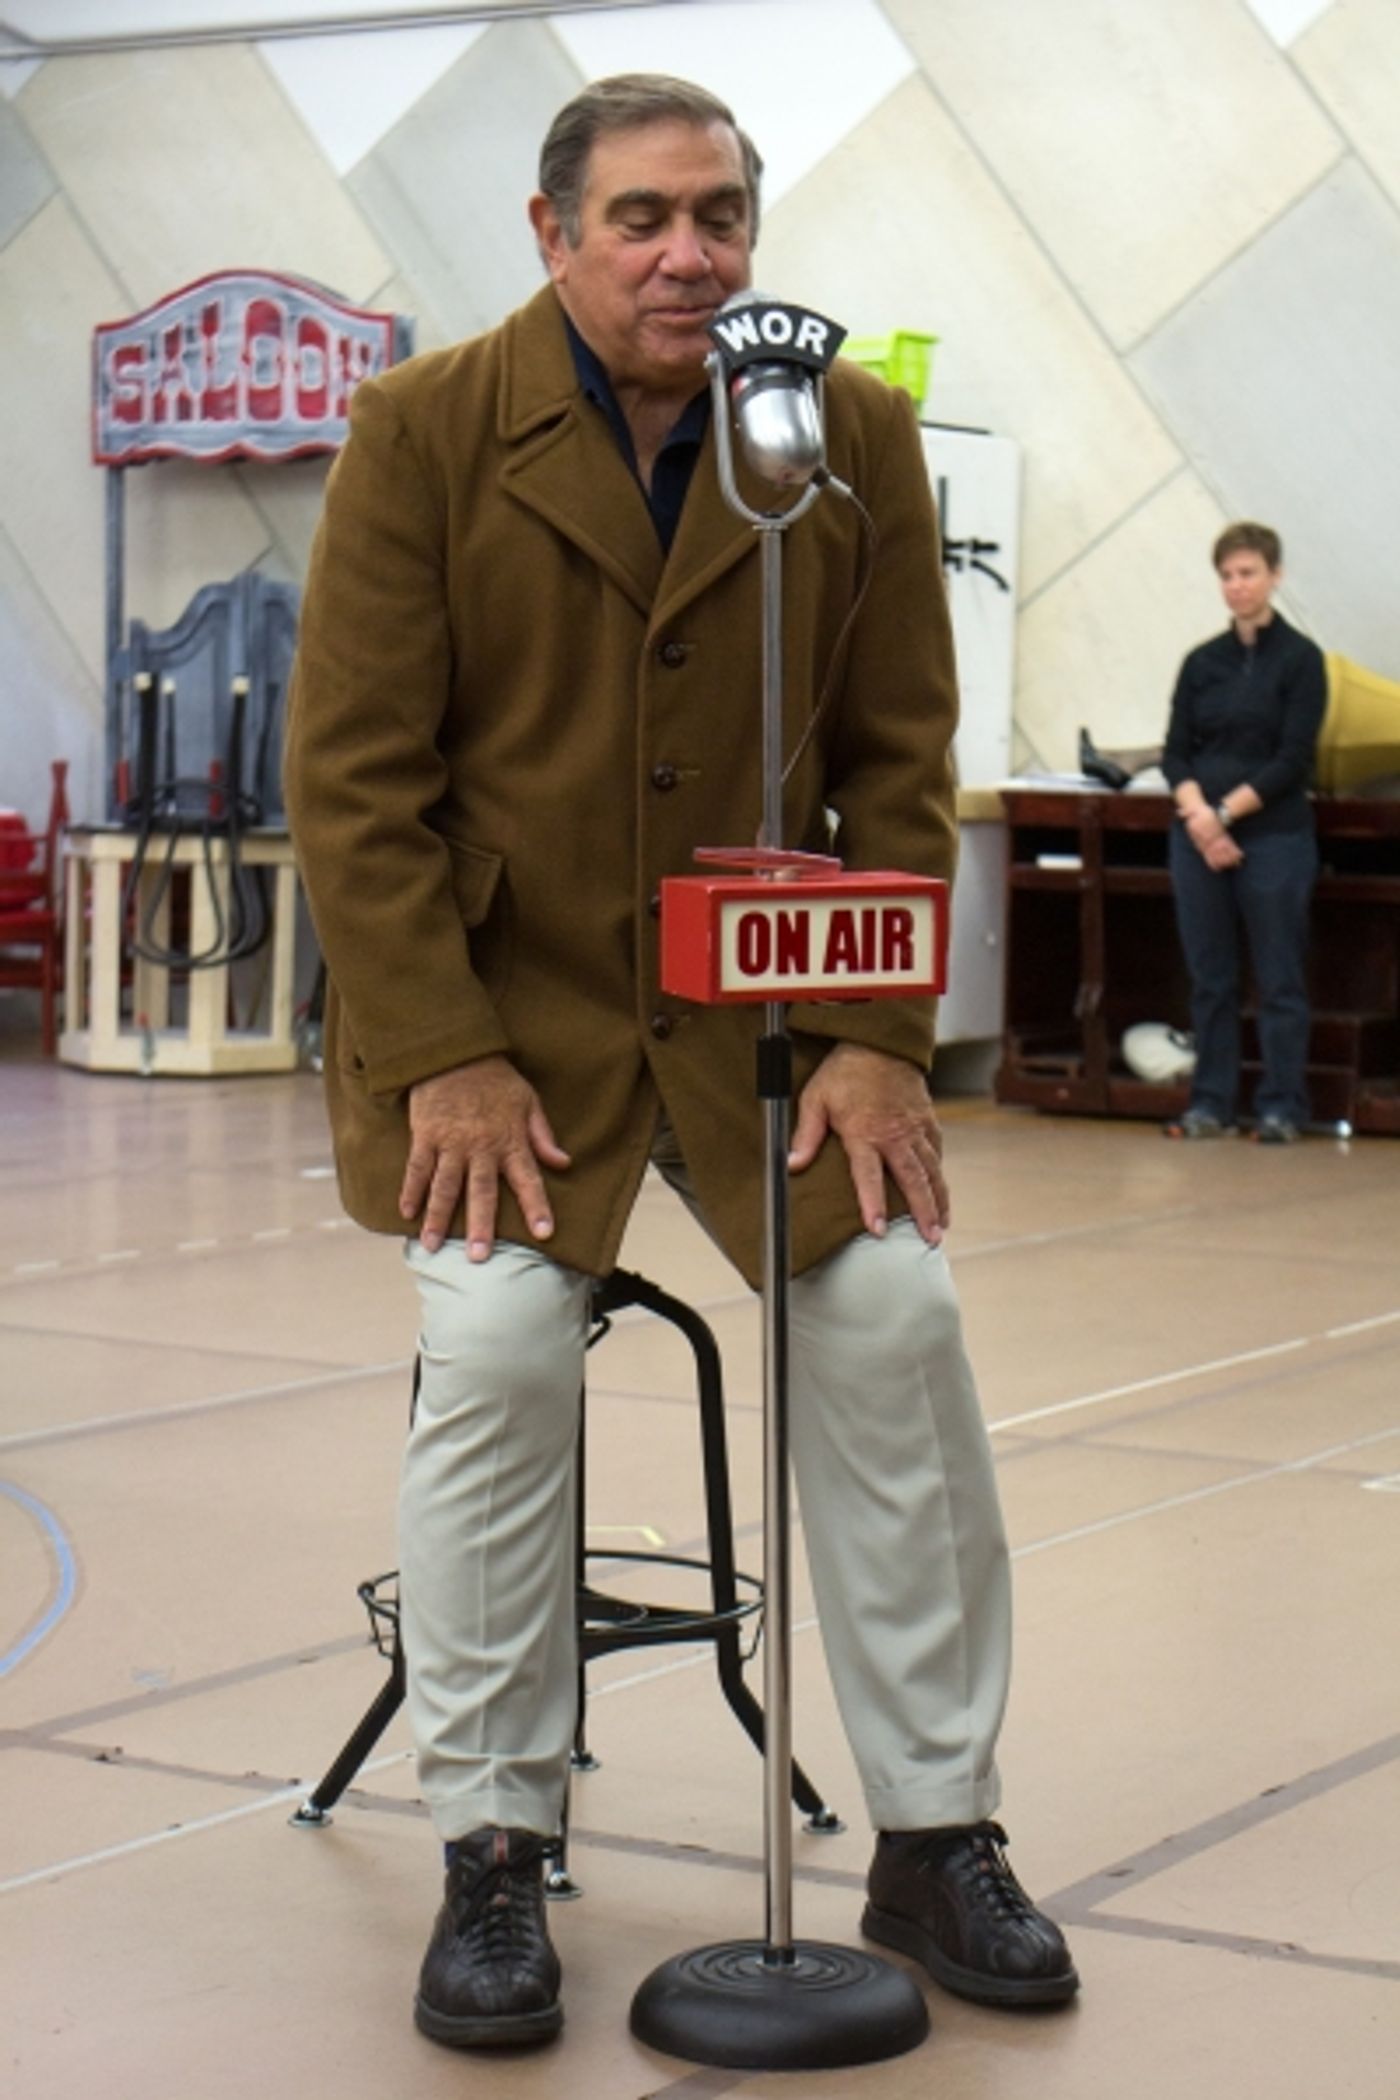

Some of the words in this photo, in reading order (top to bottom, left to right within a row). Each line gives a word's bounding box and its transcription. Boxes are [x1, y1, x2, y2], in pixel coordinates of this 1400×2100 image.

[714, 309, 828, 356] WOR
[736, 910, 809, 977] ON
[823, 907, 914, 974] AIR
